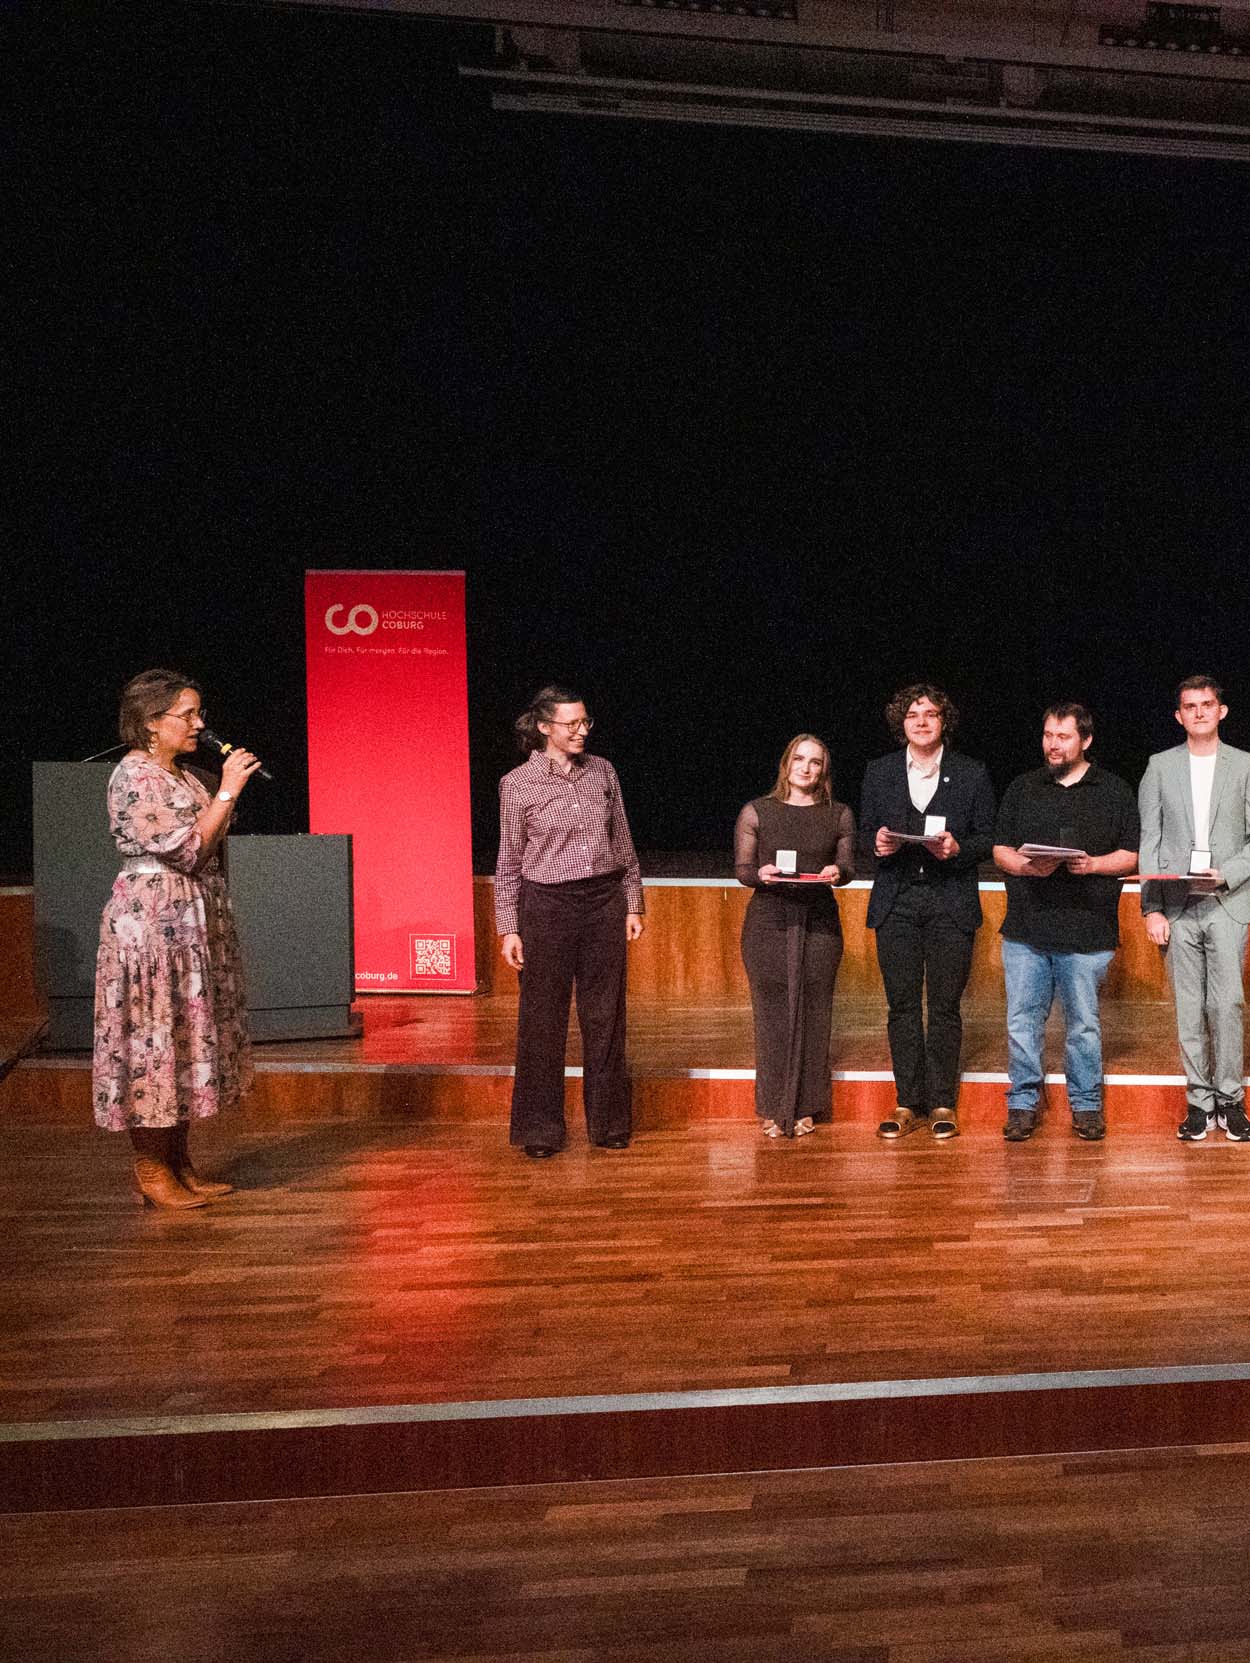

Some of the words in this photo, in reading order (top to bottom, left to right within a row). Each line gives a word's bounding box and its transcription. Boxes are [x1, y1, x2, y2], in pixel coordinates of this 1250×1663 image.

[324, 604, 379, 635] CO
[382, 610, 447, 620] HOCHSCHULE
[382, 621, 424, 630] COBURG
